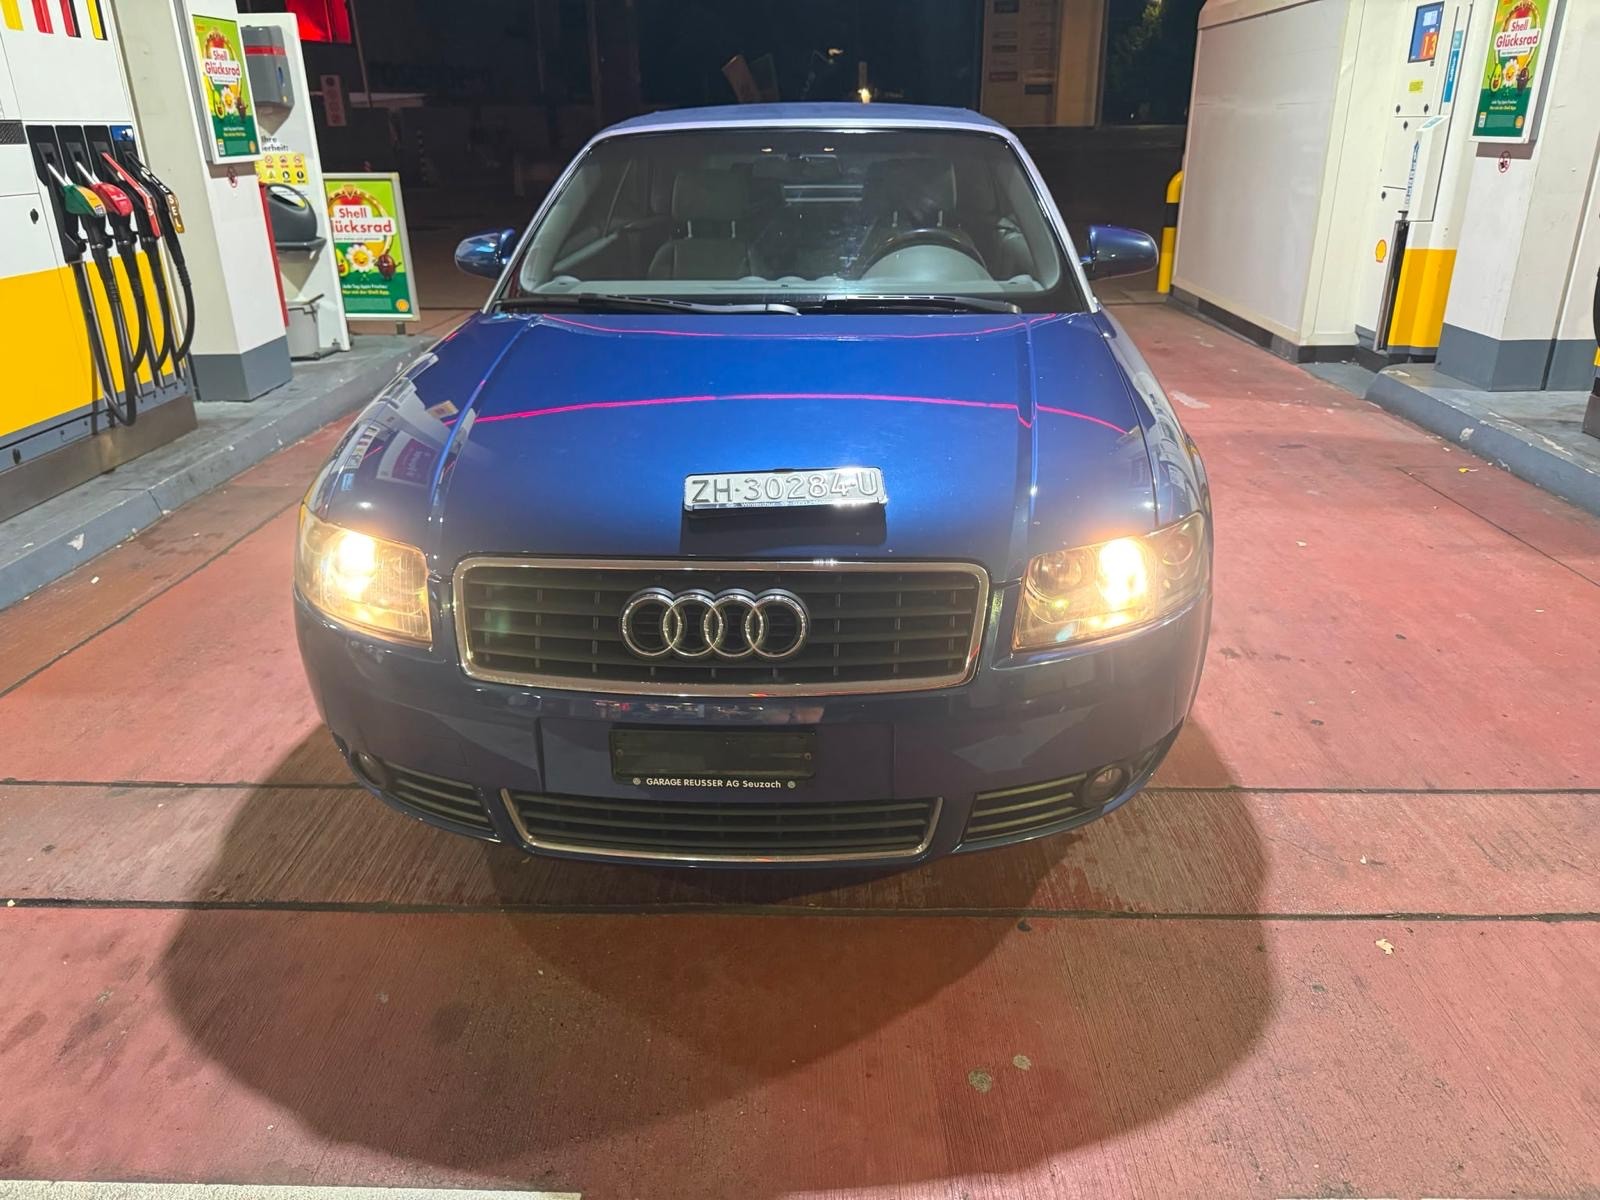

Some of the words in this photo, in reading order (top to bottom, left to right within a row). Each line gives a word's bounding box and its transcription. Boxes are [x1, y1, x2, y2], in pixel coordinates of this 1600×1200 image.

[1511, 20, 1528, 32] Shell
[1496, 30, 1540, 48] Glücksrad
[213, 50, 228, 61] Shell
[205, 61, 241, 76] Glücksrad
[339, 207, 367, 219] Shell
[332, 219, 392, 233] lücksrad
[646, 777, 682, 786] GARAGE
[683, 778, 723, 787] REUSSER
[726, 779, 740, 788] AG
[742, 780, 782, 788] Seuzach
